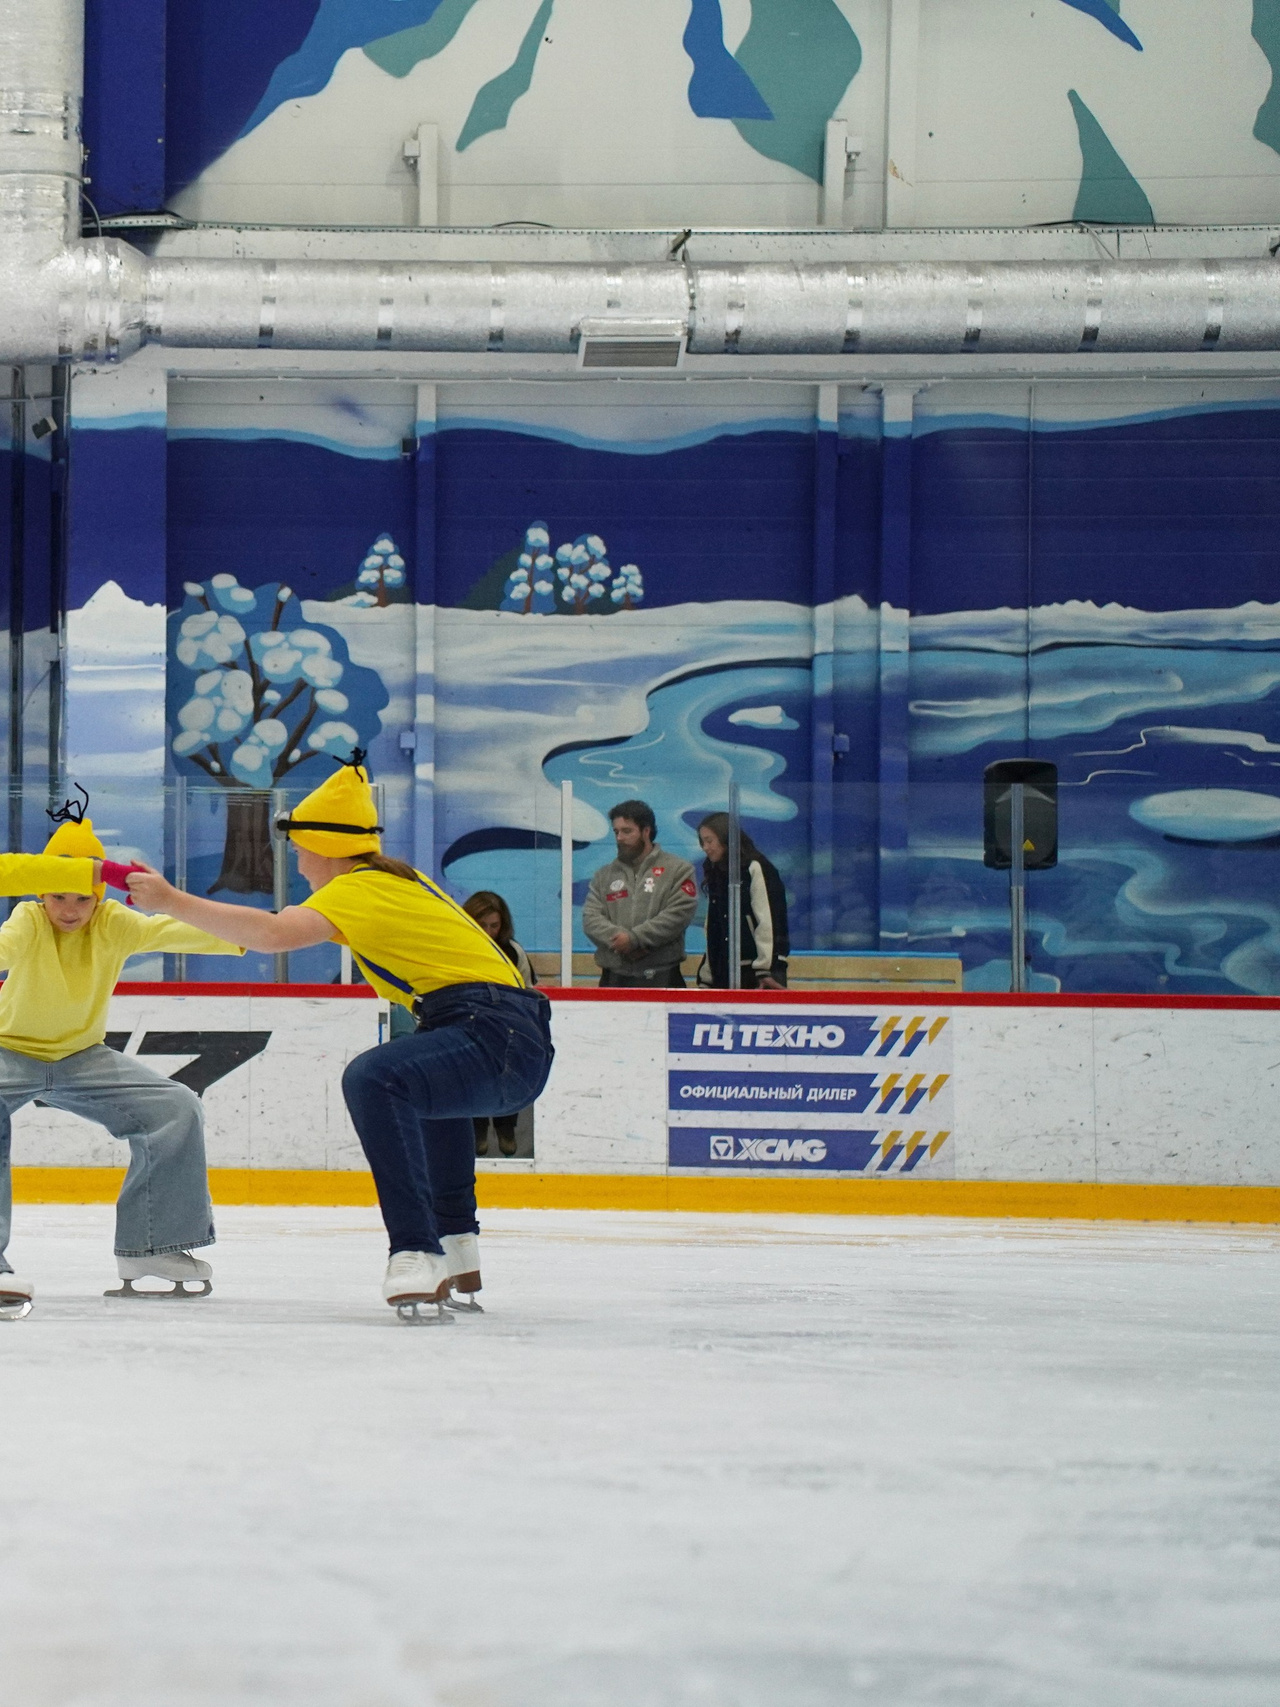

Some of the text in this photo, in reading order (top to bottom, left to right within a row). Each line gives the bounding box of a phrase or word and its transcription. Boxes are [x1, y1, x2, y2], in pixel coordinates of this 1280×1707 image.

[692, 1023, 846, 1050] ГЦ ТЕХНО
[679, 1084, 857, 1102] ОФИЦИАЛЬНЫЙ ДИЛЕР
[733, 1138, 827, 1163] XCMG
